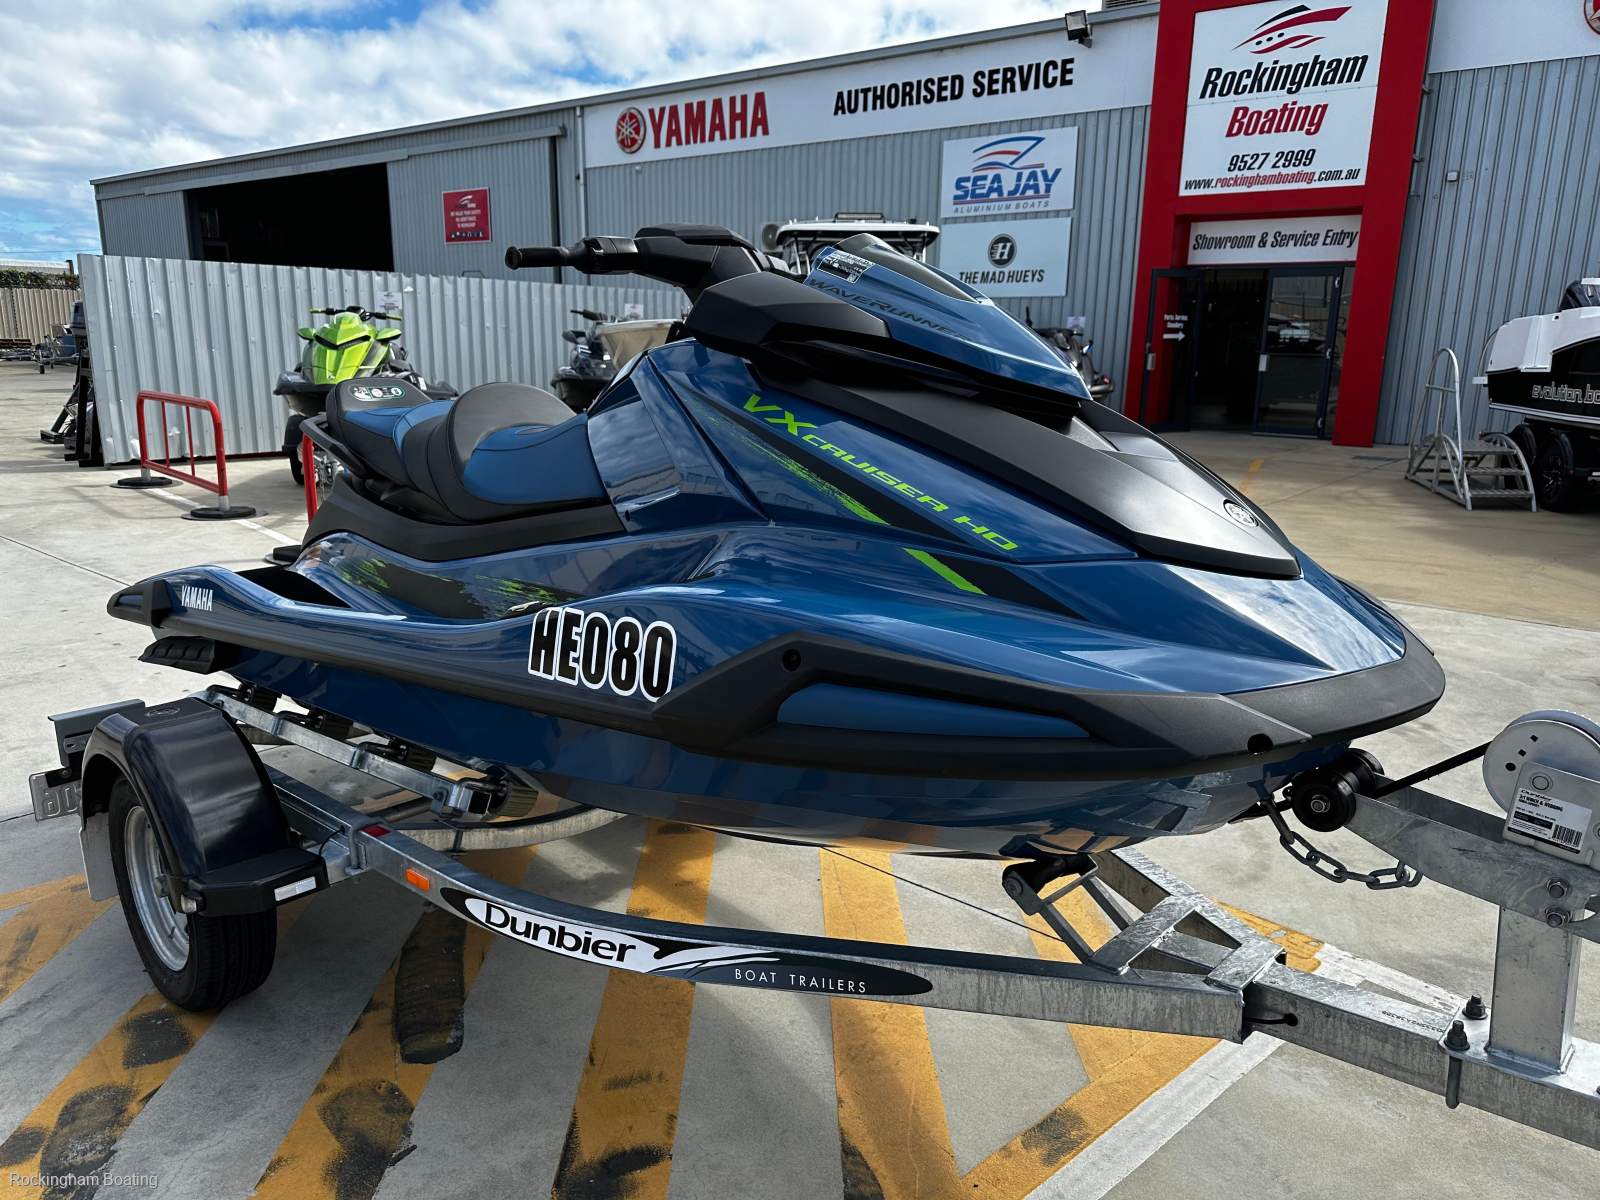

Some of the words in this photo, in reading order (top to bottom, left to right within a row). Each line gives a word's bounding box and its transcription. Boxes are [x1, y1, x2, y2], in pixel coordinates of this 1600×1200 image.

[833, 74, 965, 116] AUTHORISED
[972, 58, 1075, 98] SERVICE
[1199, 55, 1369, 99] Rockingham
[648, 91, 770, 149] YAMAHA
[1225, 101, 1328, 138] Boating
[1228, 152, 1270, 172] 9527
[1272, 148, 1316, 169] 2999
[953, 173, 1004, 201] SEA
[1007, 168, 1062, 196] JAY
[1184, 168, 1361, 191] www.rockinghamboating.com.au
[953, 203, 1012, 214] ALUMINIUM
[1015, 200, 1050, 210] BOATS
[1193, 233, 1256, 250] Showroom
[1258, 231, 1269, 248] &
[1270, 230, 1320, 248] Service
[1322, 229, 1358, 248] Entry
[959, 271, 979, 285] THE
[981, 270, 1005, 284] MAD
[1008, 269, 1045, 283] HUEYS
[743, 394, 818, 437] VX
[802, 433, 949, 513] CRUISER
[181, 585, 213, 611] YAMAHA
[528, 607, 677, 703] HE080
[484, 901, 636, 962] Dunbier
[735, 968, 777, 983] BOAT
[789, 974, 866, 993] TRAILERS
